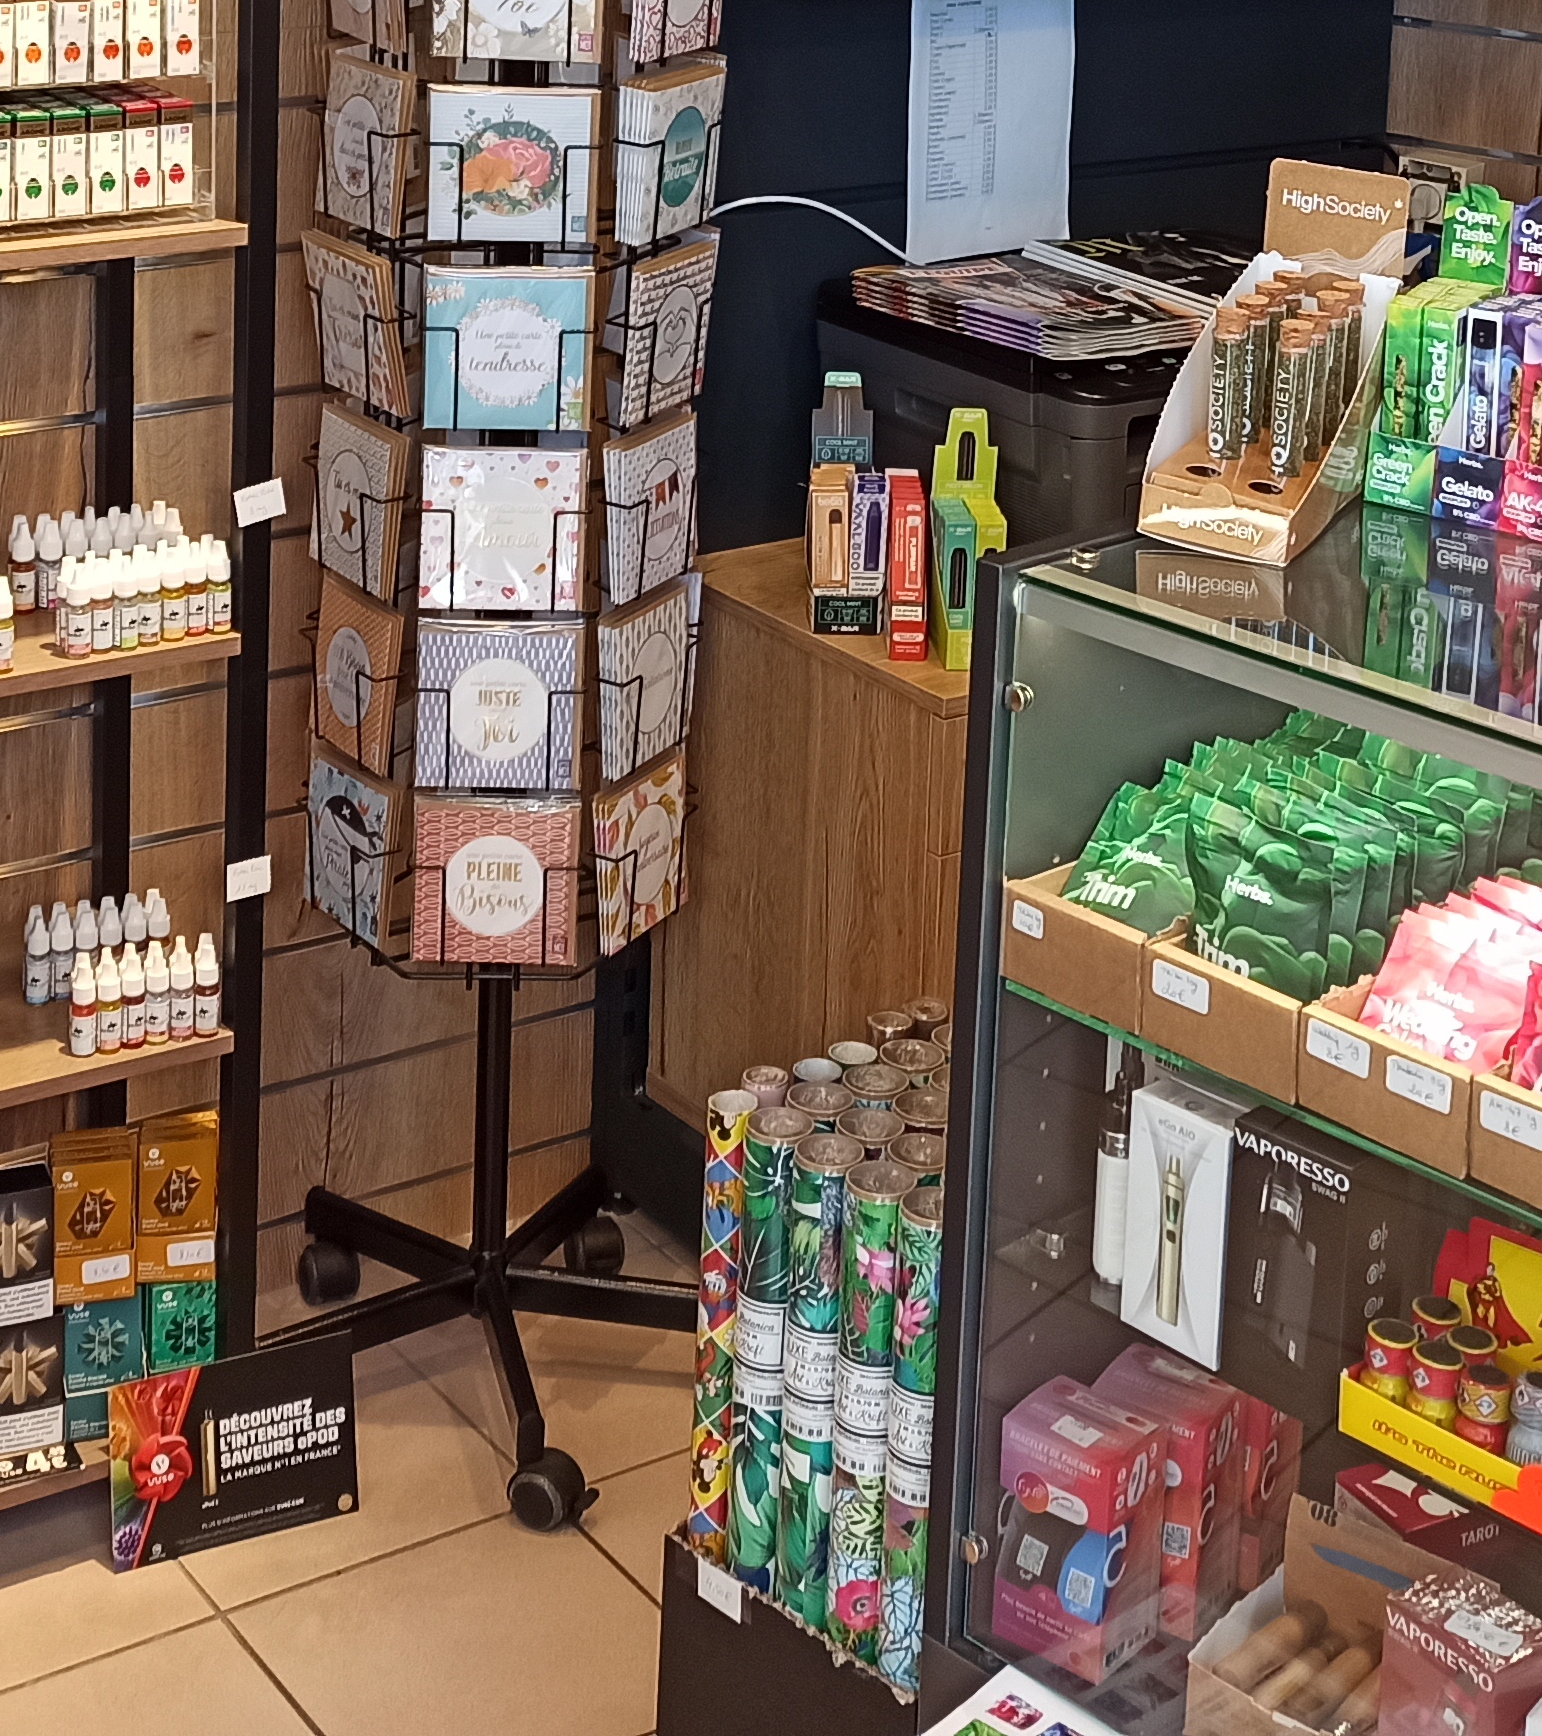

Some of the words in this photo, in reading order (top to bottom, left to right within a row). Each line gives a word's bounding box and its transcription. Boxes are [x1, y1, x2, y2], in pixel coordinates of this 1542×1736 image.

[1282, 187, 1392, 224] HighSociety
[1455, 206, 1501, 229] Open.
[1453, 225, 1497, 246] Taste.
[1451, 243, 1495, 266] Enjoy.
[1441, 476, 1494, 502] Gelato
[466, 861, 522, 883] PLEINE
[456, 883, 532, 916] Bisous
[1081, 871, 1136, 909] Trim
[1235, 1126, 1350, 1193] VAPORESSO
[219, 1397, 312, 1436] DÉCOUVREZ
[220, 1414, 312, 1452] L'INTENSITÉ
[316, 1407, 345, 1429] DES
